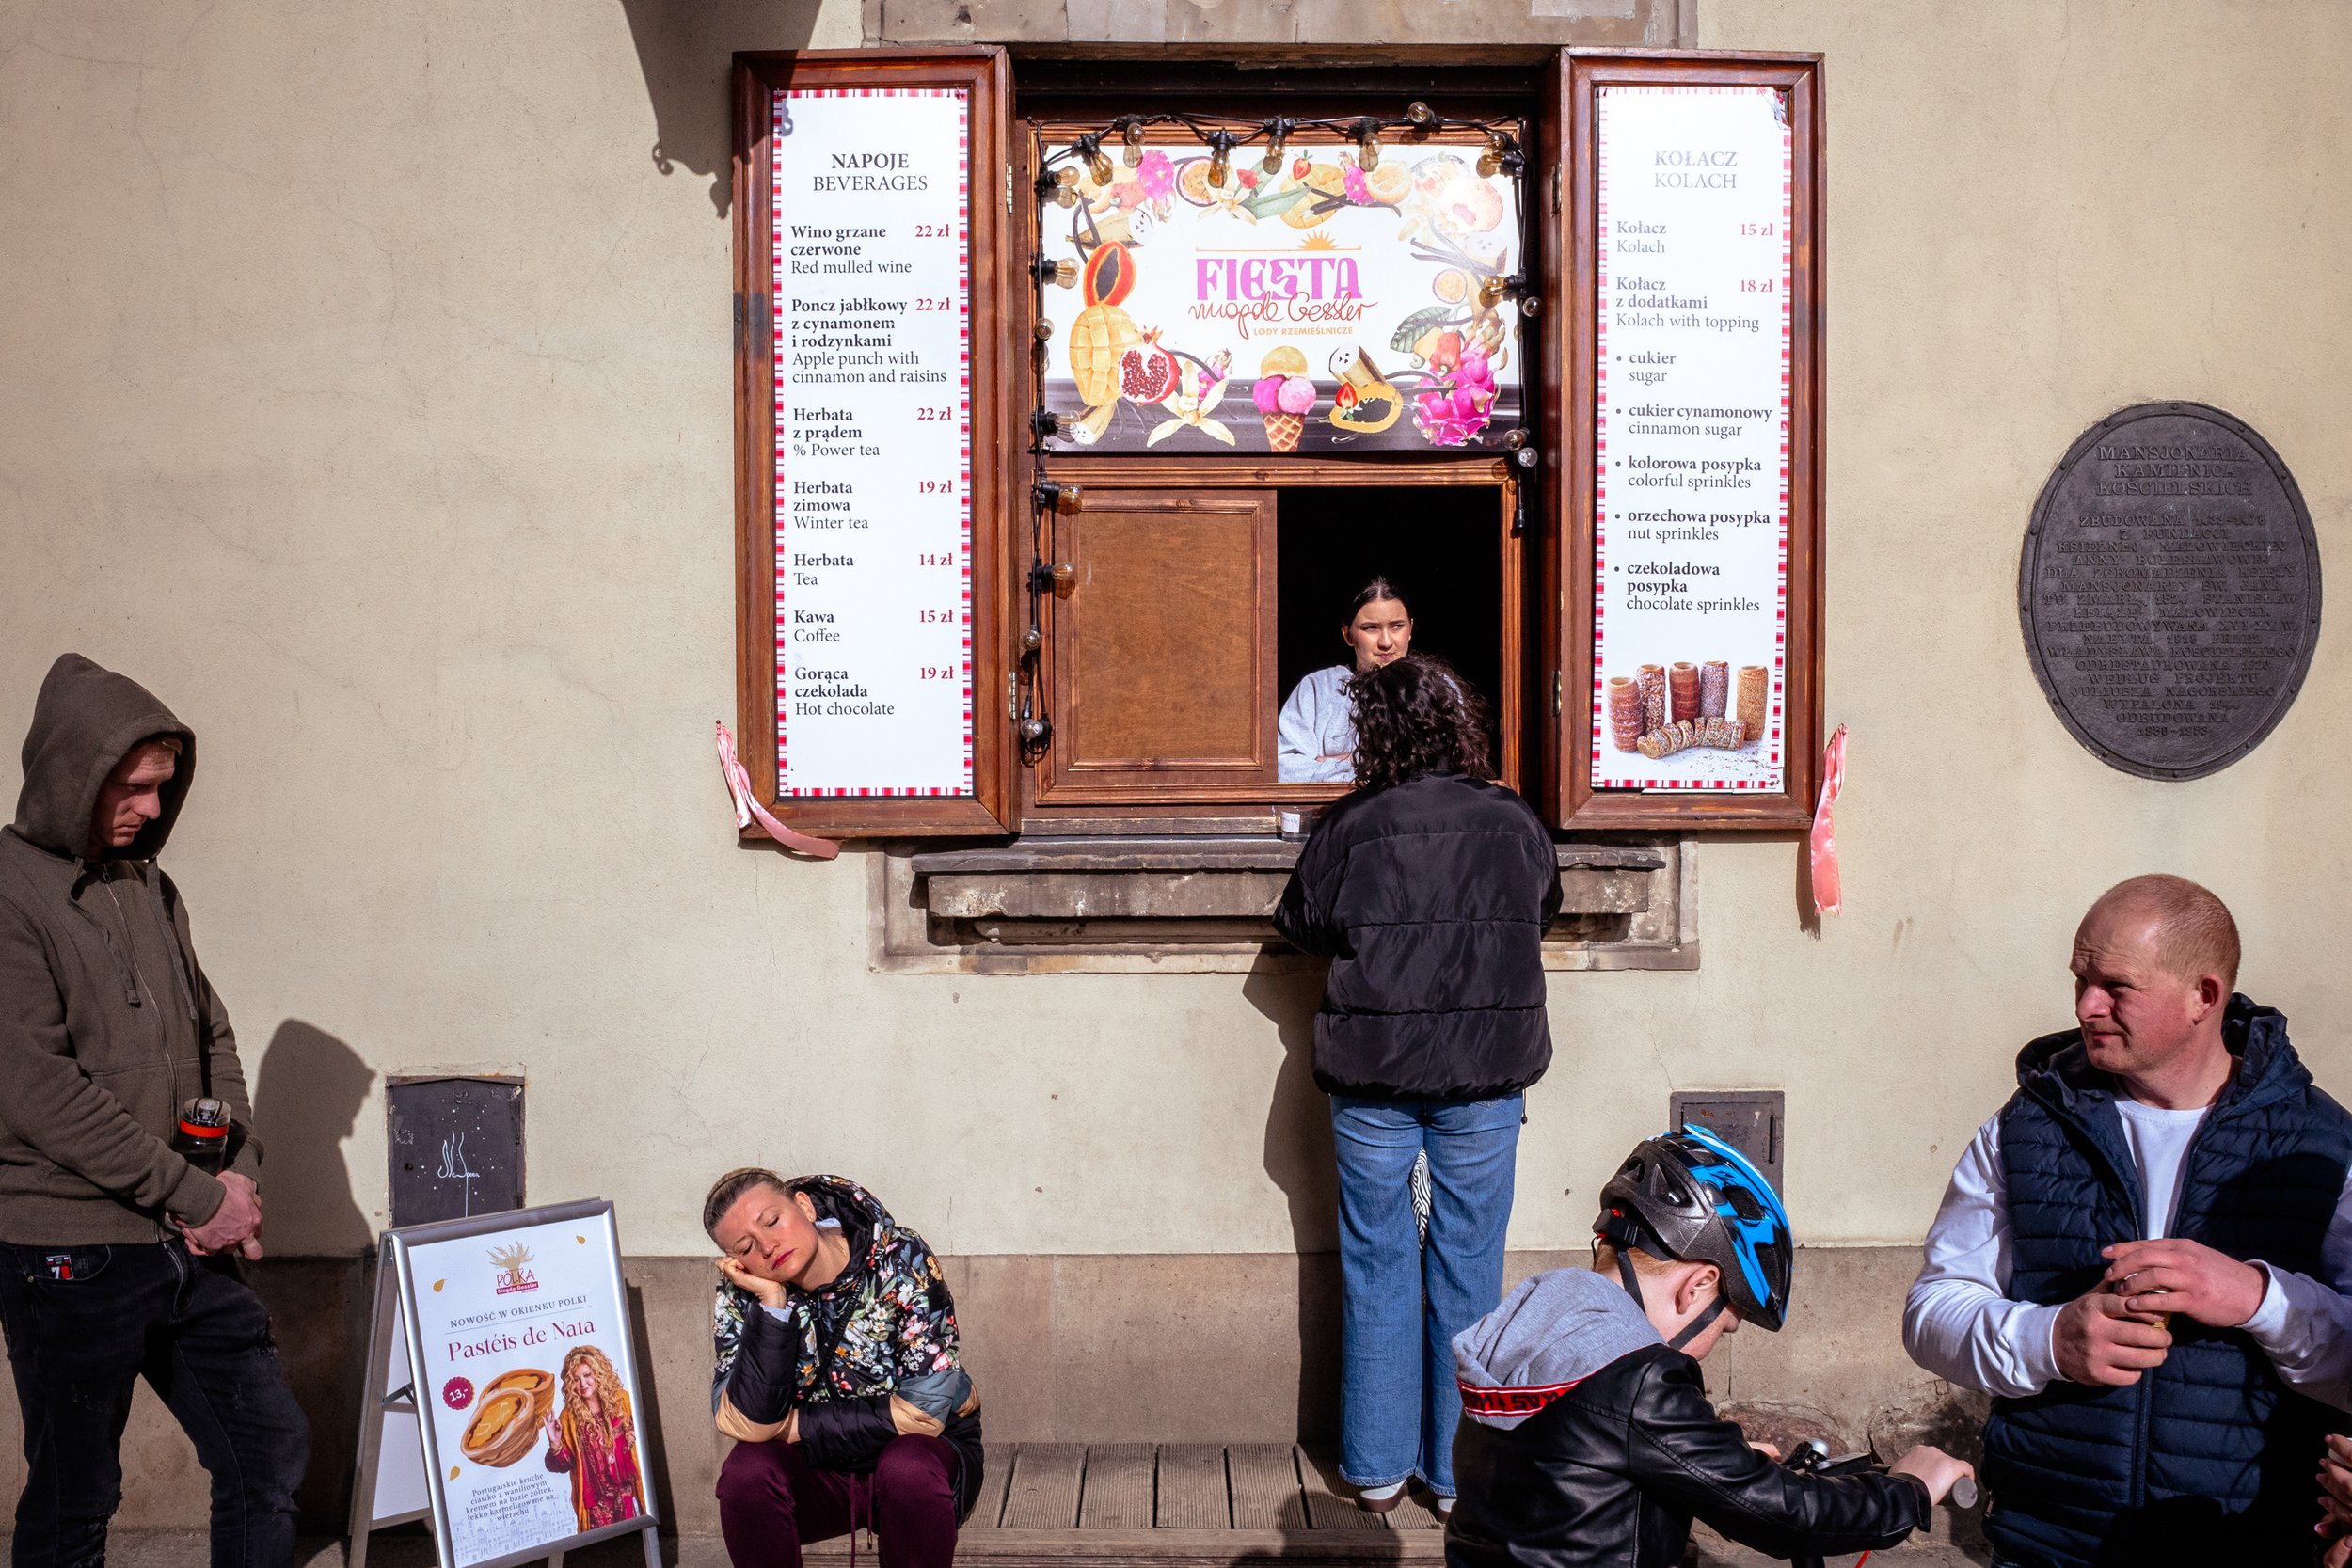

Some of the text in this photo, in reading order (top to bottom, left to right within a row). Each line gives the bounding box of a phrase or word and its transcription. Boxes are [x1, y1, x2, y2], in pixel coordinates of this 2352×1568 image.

[832, 153, 909, 171] NAPOJE
[1655, 151, 1737, 166] KOŁACZ
[813, 176, 927, 191] BEVERAGES
[1655, 173, 1737, 188] KOLACH
[791, 224, 949, 242] Wino grzane 22 zł
[1617, 221, 1773, 236] Kołacz 15 zł
[791, 246, 861, 256] czerwone
[1617, 239, 1665, 253] Kolach
[792, 260, 912, 274] Red mulled wine
[1196, 257, 1363, 300] FIESTA
[1616, 277, 1772, 292] Kołacz 18 zł
[792, 297, 950, 315] Poncz jabłkowy 22 zł
[1616, 294, 1708, 309] z dodatkami
[792, 320, 895, 333] z cynamonem
[1281, 325, 1353, 335] RZEMIEŚLNICZE
[1616, 313, 1759, 333] Kolach with topping
[792, 334, 891, 351] i rodzynkami
[793, 351, 919, 369] Apple punch with
[1629, 351, 1676, 364] cukier
[793, 369, 946, 383] cinnamon and raisins
[1629, 372, 1667, 386] sugar
[793, 406, 951, 420] Herbata 22 zł
[1629, 404, 1772, 422] cukier cynamonowy
[793, 425, 862, 442] z prądem
[1629, 421, 1742, 439] cinnamon sugar
[812, 444, 855, 456] Power
[860, 445, 880, 455] tea
[2098, 446, 2249, 461] MANSJONARIA
[1629, 455, 1761, 474] kolorowa posypka
[2114, 464, 2236, 478] KAMIENICA
[794, 480, 952, 494] Herbata 19 zł
[1629, 473, 1751, 491] colorful sprinkles
[794, 499, 850, 511] zimowa
[794, 516, 868, 529] Winter tea
[1629, 509, 1770, 527] orzechowa posypka
[2079, 515, 2185, 527] ZBUDOWANA
[1629, 527, 1719, 544] nut sprinkles
[794, 552, 952, 566] Herbata 14 zł
[1628, 562, 1720, 575] czekoladowa
[793, 573, 818, 585] Tea
[1627, 579, 1687, 595] posypka
[1627, 595, 1759, 614] chocolate sprinkles
[794, 610, 953, 623] Kawa 15 zł
[794, 628, 839, 641] Coffee
[795, 666, 953, 684] Gorąca 19 zł
[795, 684, 867, 697] czekolada
[796, 702, 894, 715] Hot chocolate
[497, 1269, 535, 1287] POLKA
[451, 1311, 496, 1328] NOWOŚĆ
[511, 1302, 554, 1316] OKIENKU
[558, 1295, 587, 1307] POLKI
[449, 1321, 595, 1361] Pastéis de Nata
[472, 1473, 544, 1497] Portugalskie kruche
[470, 1494, 497, 1505] ciastko
[504, 1481, 548, 1496] waniliowym
[466, 1501, 497, 1513] kremem
[509, 1493, 529, 1502] bazie
[489, 1497, 544, 1515] karmelizowane
[497, 1508, 530, 1521] wierzchu
